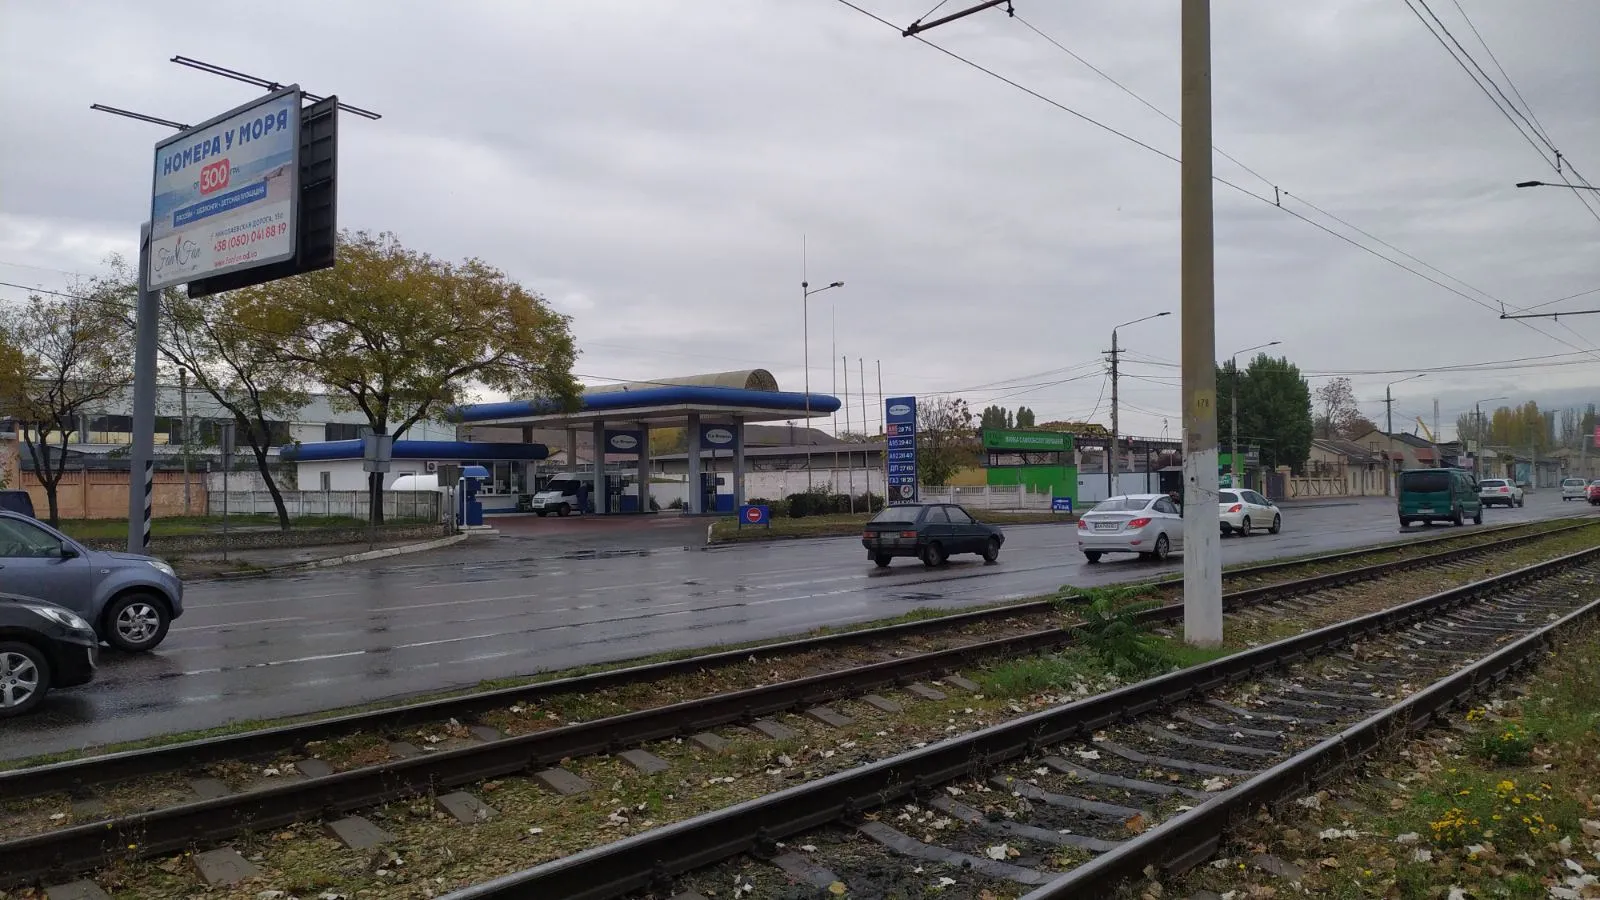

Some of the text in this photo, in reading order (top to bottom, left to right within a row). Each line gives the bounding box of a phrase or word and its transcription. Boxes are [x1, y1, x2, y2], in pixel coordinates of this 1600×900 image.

[164, 108, 288, 176] НОМЕРА У МОРЯ
[201, 163, 227, 191] 300
[213, 222, 287, 252] +38 (050) 041 88 19
